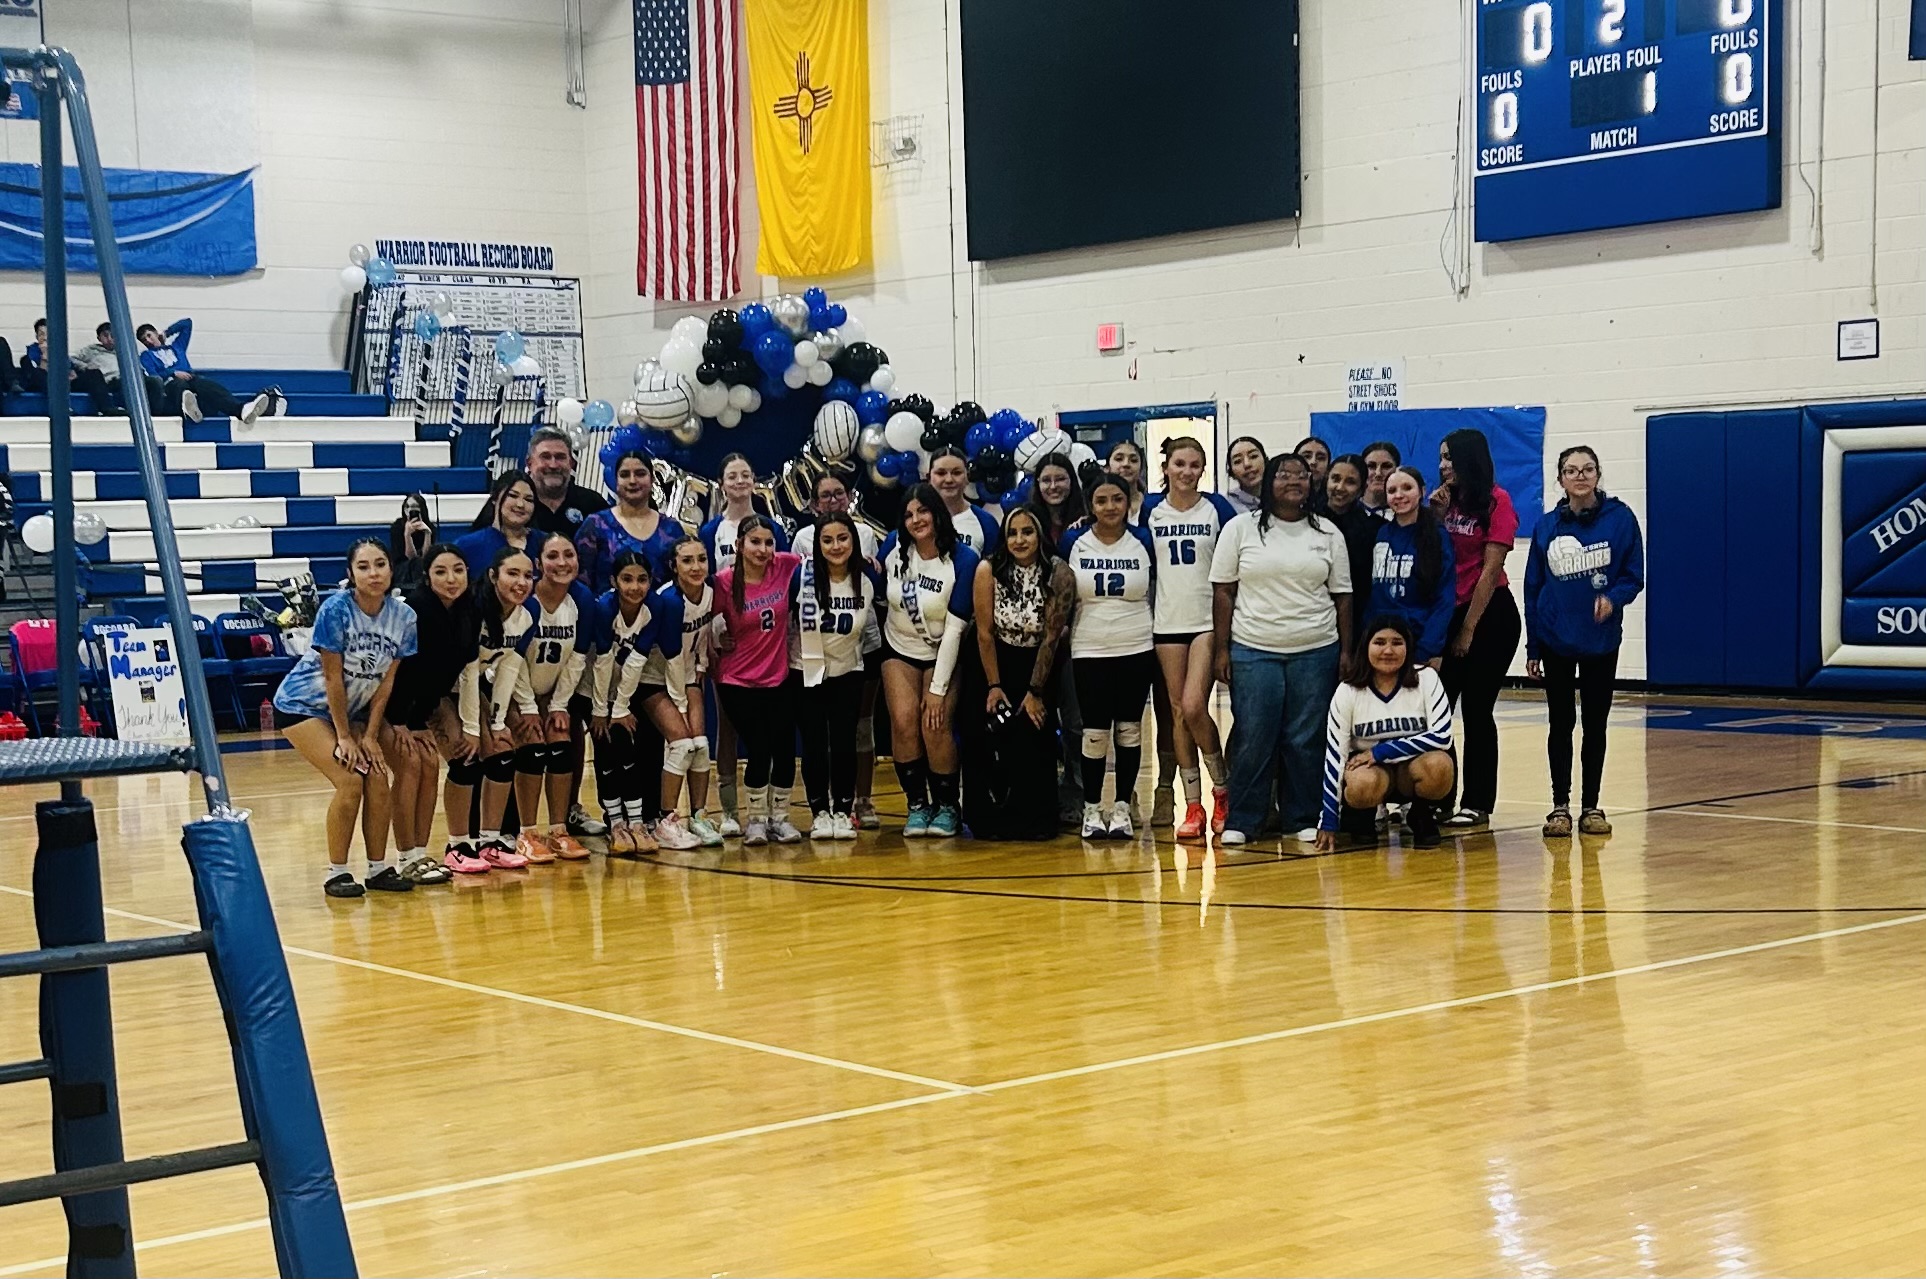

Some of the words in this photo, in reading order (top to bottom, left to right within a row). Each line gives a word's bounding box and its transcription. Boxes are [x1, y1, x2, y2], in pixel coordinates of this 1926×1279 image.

[1524, 2, 1553, 61] 0
[1600, 0, 1626, 42] 2
[1711, 28, 1759, 54] FOULS
[1570, 51, 1620, 78] PLAYER
[1626, 46, 1663, 68] FOUL
[1481, 70, 1523, 94] FOULS
[1725, 52, 1753, 103] 0
[1643, 70, 1656, 113] 1
[1494, 92, 1518, 138] 0
[1710, 108, 1759, 133] SCORE
[1590, 126, 1638, 150] MATCH
[1481, 144, 1523, 167] SCORE
[375, 240, 427, 265] WARRIOR
[428, 241, 481, 267] FOOTBALL
[481, 243, 520, 268] RECORD
[521, 246, 554, 270] BOARD
[1349, 367, 1375, 381] PLEASE
[1381, 367, 1392, 380] NO
[1348, 384, 1372, 398] STREET
[1373, 383, 1397, 397] SHOES
[1154, 524, 1212, 537] WARRIORS
[1080, 558, 1140, 570] WARRIORS
[1168, 539, 1196, 565] 16
[802, 559, 817, 632] ENIOR
[1094, 572, 1125, 597] 12
[743, 590, 784, 612] WARRIORS
[760, 608, 775, 632] 2
[820, 612, 854, 636] 20
[107, 631, 147, 652] Team
[535, 641, 562, 664] 13
[110, 654, 178, 682] Manager
[118, 705, 155, 730] Thank
[1354, 716, 1428, 738] WARRIORS
